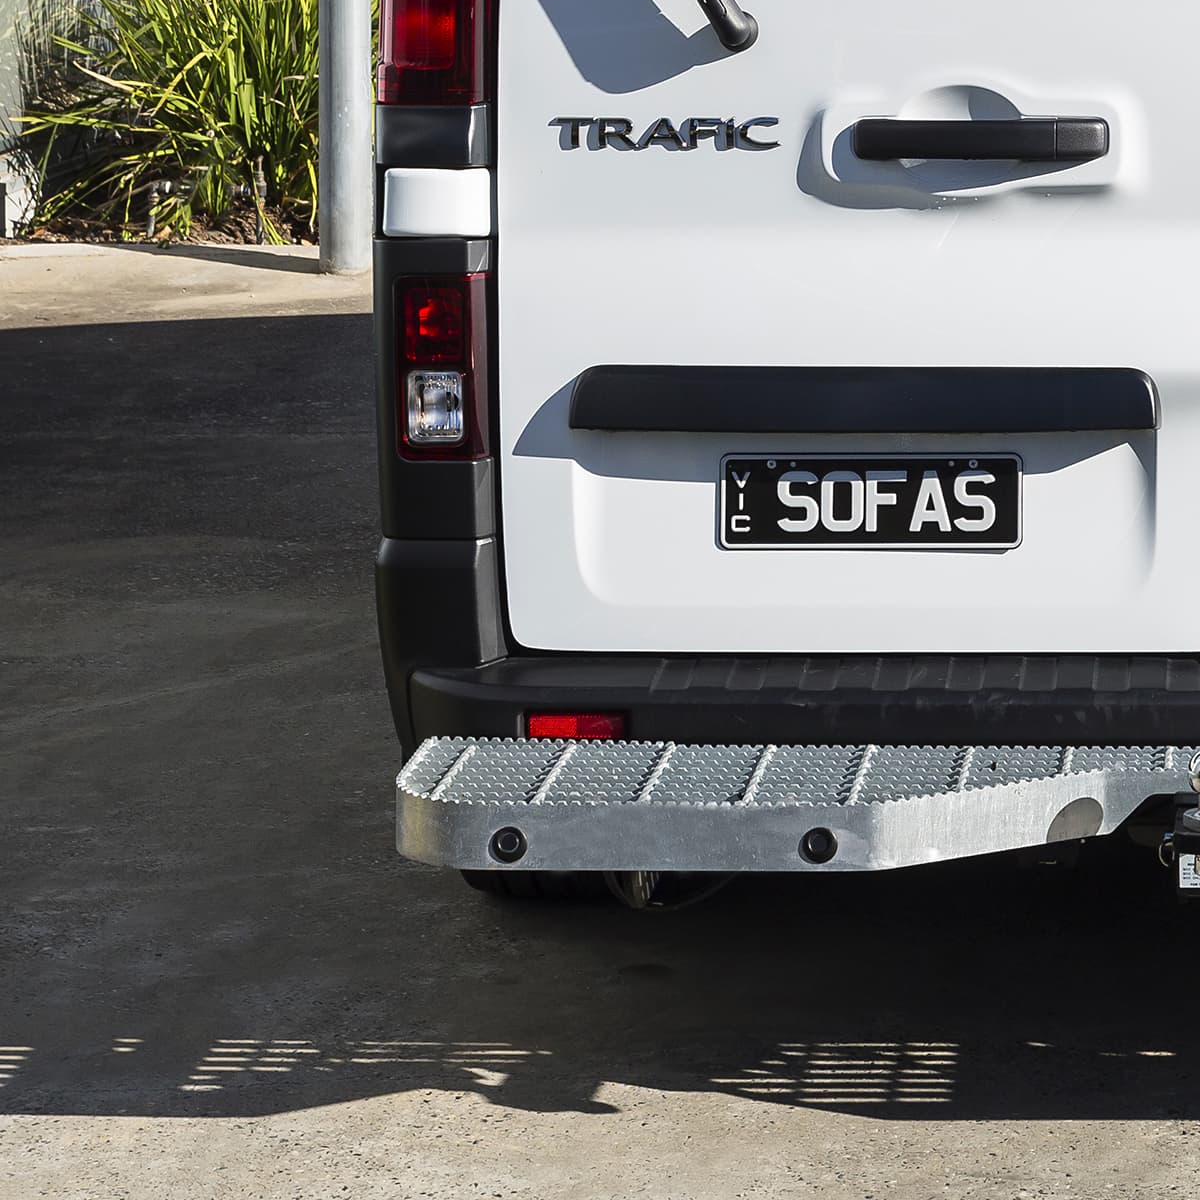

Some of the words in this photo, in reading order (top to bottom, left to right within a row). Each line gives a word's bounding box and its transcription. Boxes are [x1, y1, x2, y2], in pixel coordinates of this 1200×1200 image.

[547, 117, 782, 151] TRAFIC
[730, 470, 751, 533] VIC
[776, 469, 997, 533] SOFAS
